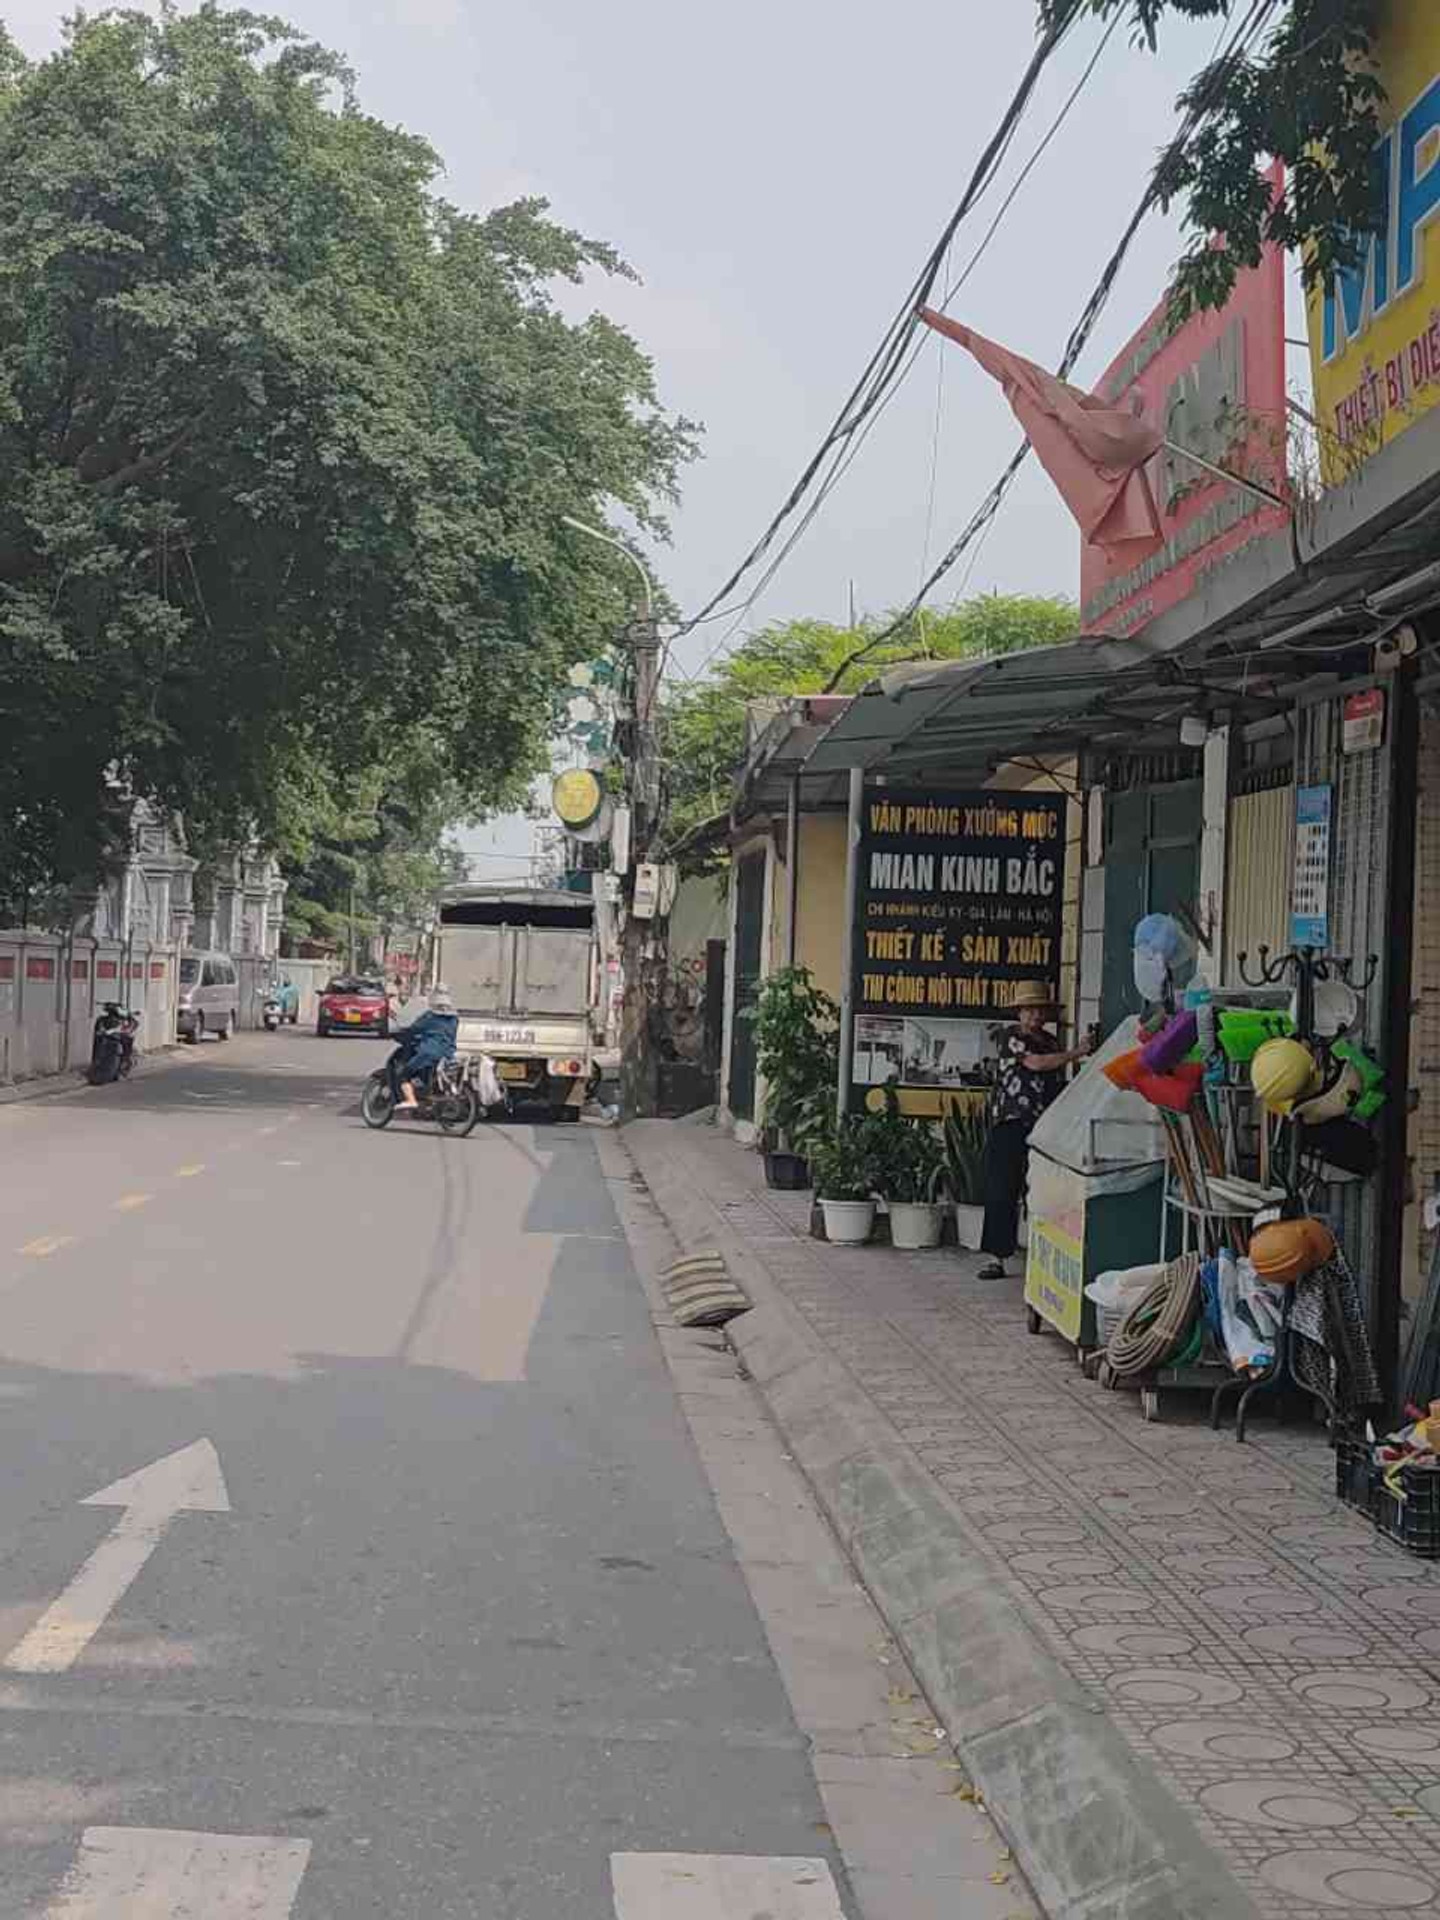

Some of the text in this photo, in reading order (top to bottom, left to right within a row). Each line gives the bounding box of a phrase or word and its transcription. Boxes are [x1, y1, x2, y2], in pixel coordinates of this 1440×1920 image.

[871, 798, 1058, 843] VĂN PHÒNG XƯỞNG MỘC
[870, 845, 1056, 897] MIAN KINH BẮC
[866, 924, 914, 960] THIẾT
[921, 925, 947, 961] KẾ
[961, 926, 999, 964] SẢN
[1007, 929, 1051, 966] XUẤT
[863, 974, 884, 1001] THI
[886, 970, 925, 1004] CÔNG
[928, 972, 951, 1008] NỘI
[953, 969, 988, 1007] THẤT
